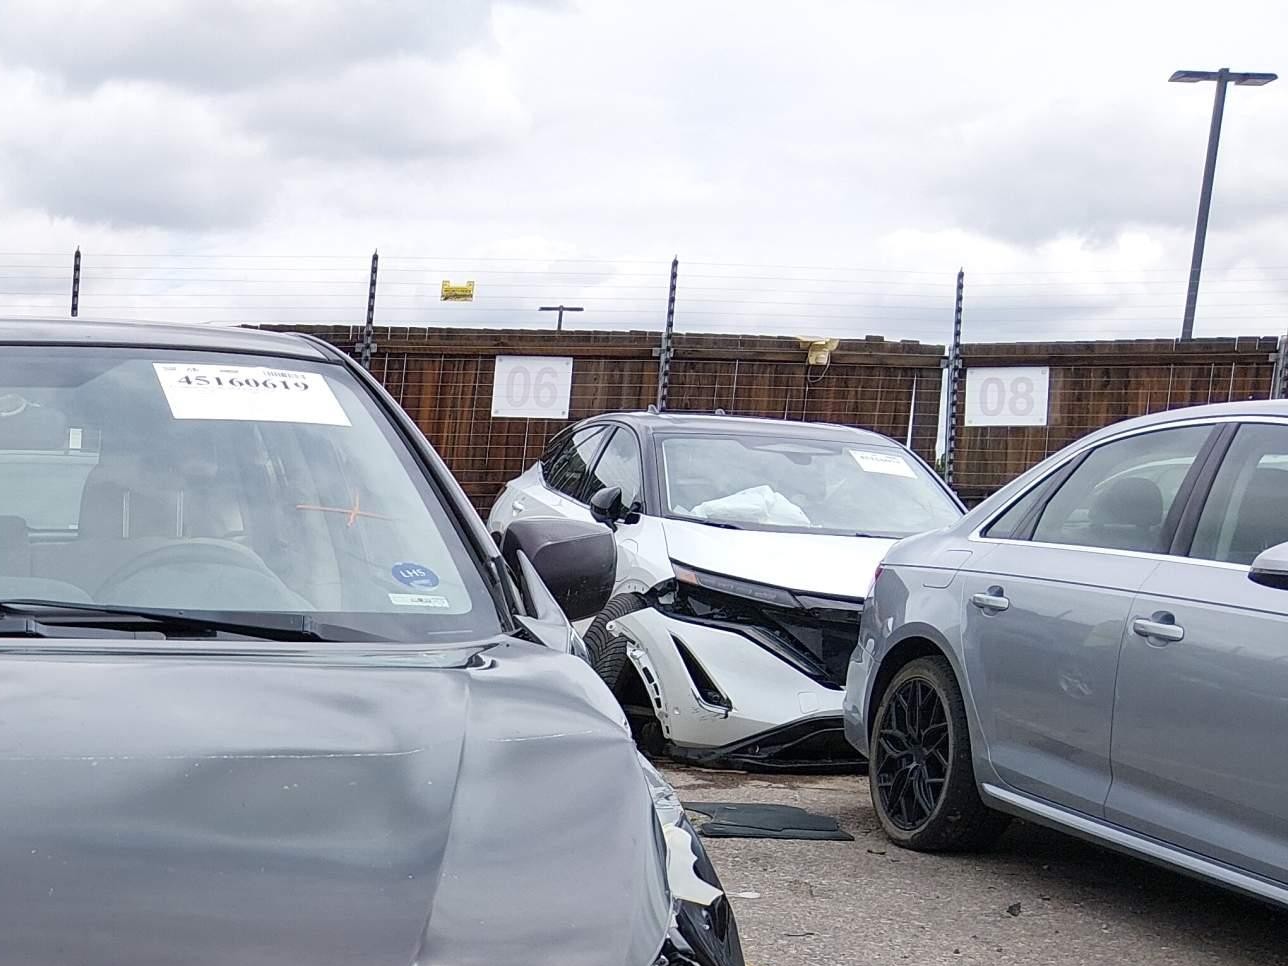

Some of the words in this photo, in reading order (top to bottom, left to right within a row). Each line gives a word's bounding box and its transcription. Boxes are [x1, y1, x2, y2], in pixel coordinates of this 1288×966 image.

[177, 374, 310, 392] 45160619
[505, 366, 558, 408] 06
[979, 376, 1034, 416] 08
